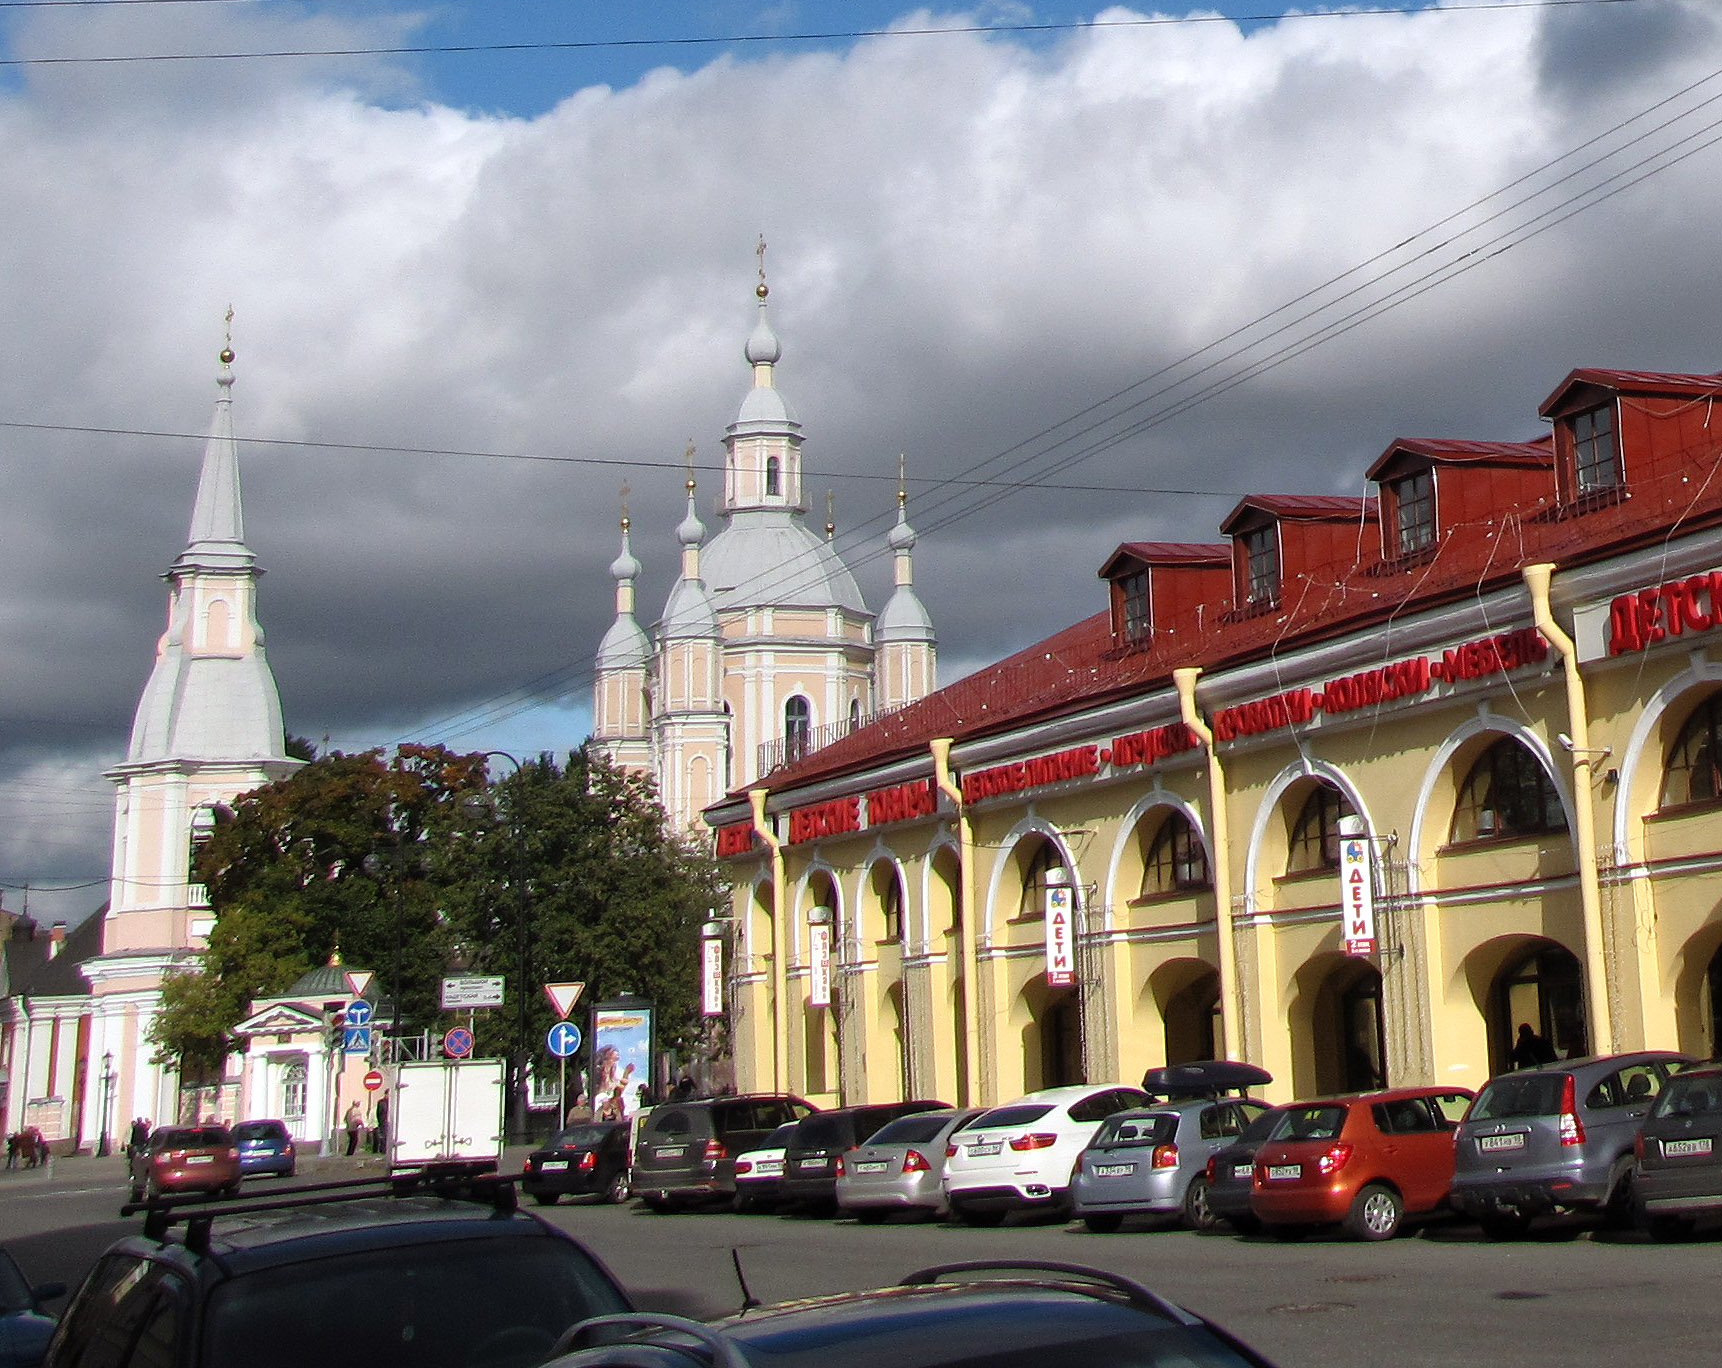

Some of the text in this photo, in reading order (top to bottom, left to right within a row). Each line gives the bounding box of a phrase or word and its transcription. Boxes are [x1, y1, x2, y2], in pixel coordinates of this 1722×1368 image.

[1212, 628, 1548, 742] КРОВАТКИ КОЛЯСКИ МЕБЕЛЬ
[1349, 868, 1366, 935] ДЕТИ
[1052, 912, 1066, 969] ДЕТИ
